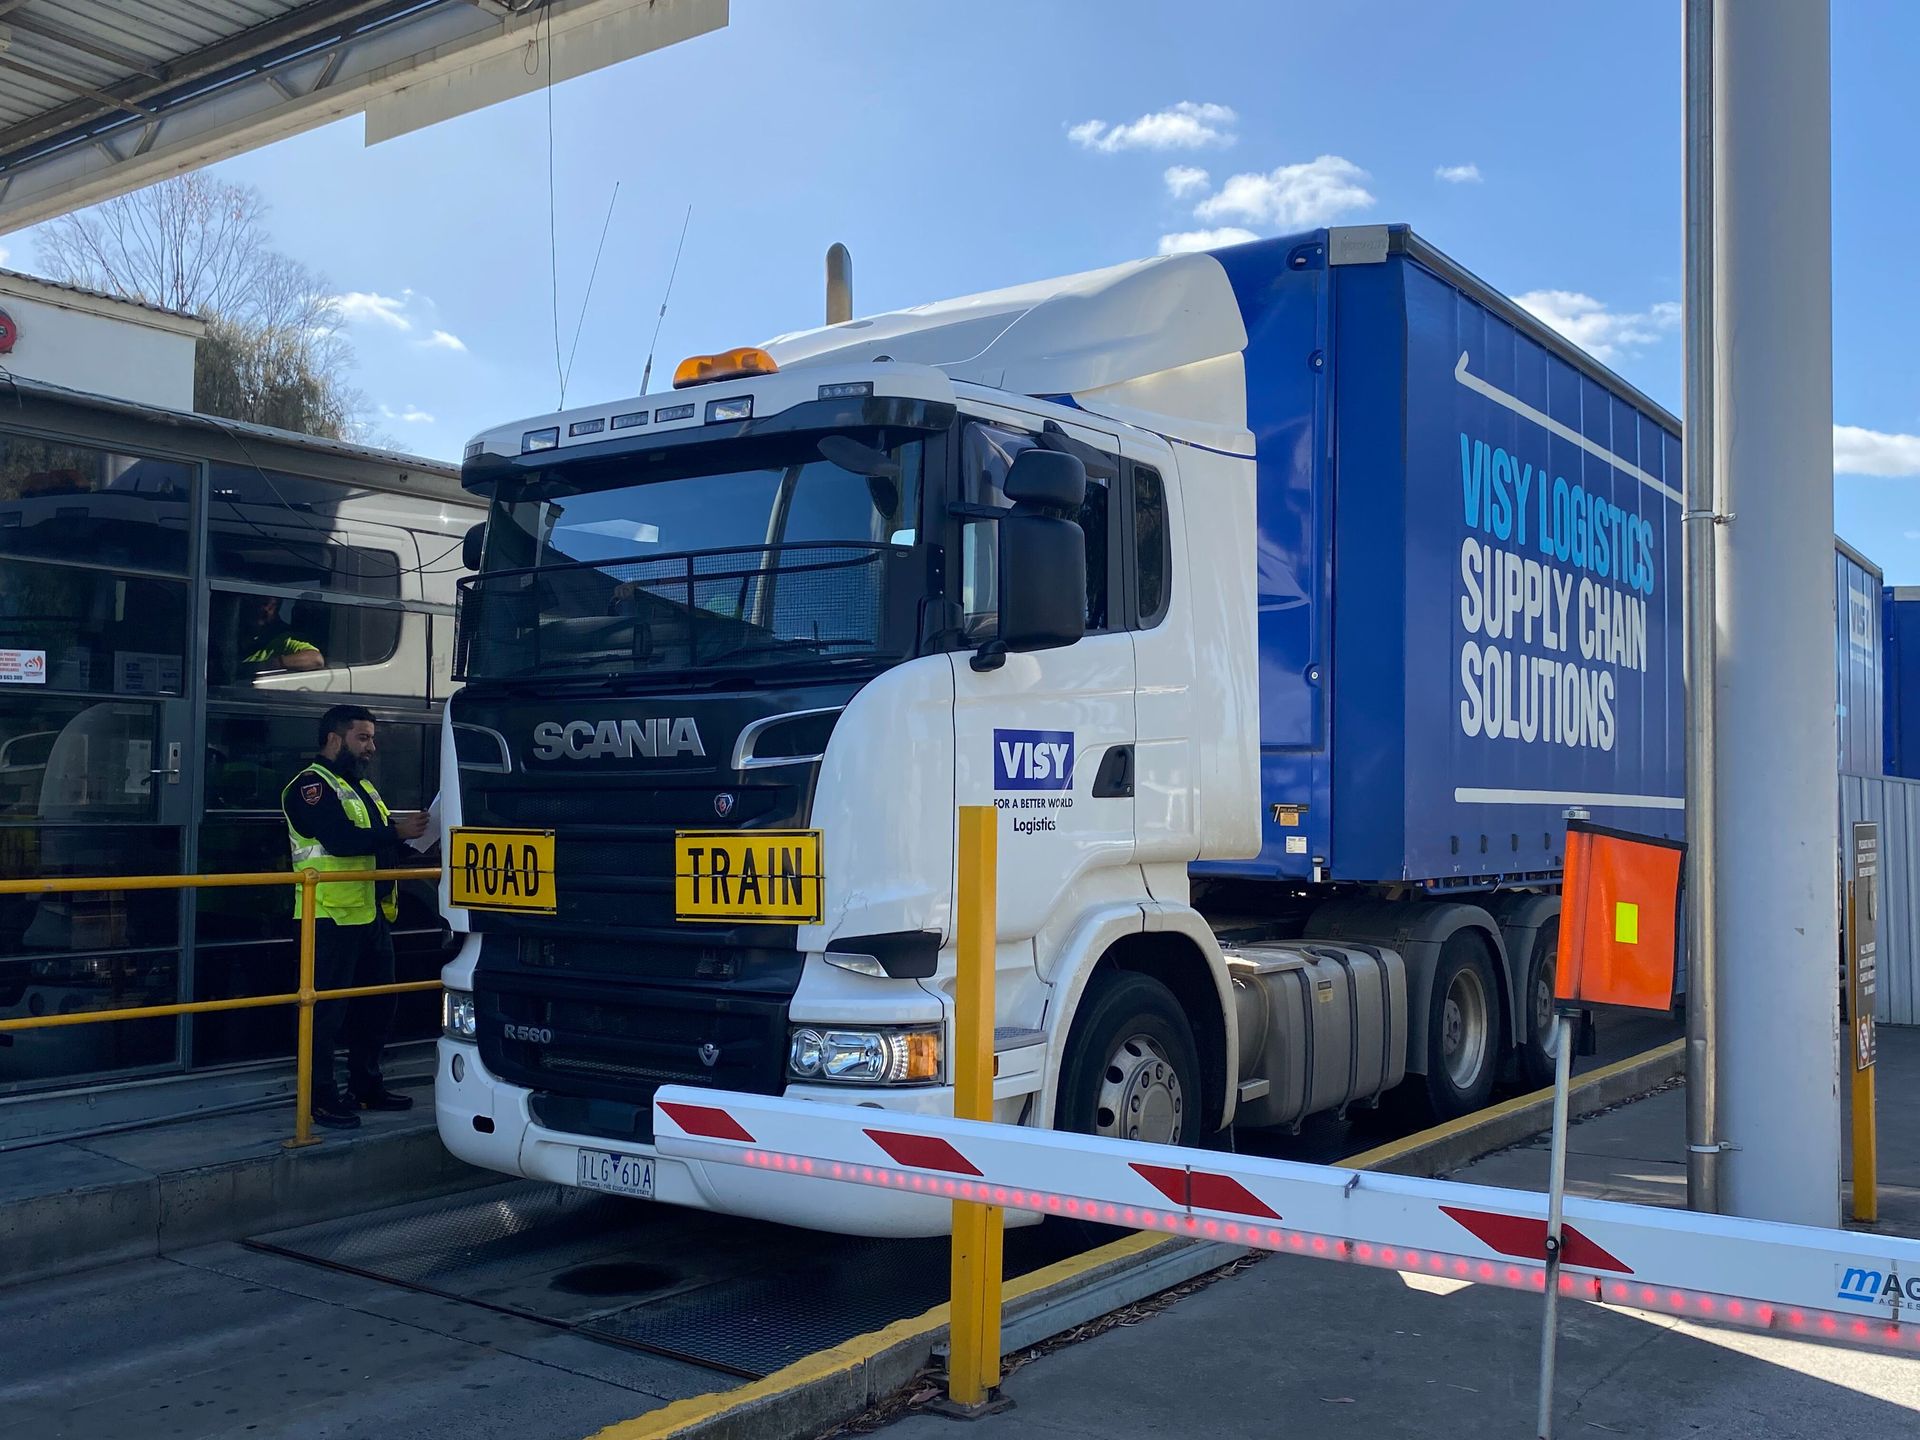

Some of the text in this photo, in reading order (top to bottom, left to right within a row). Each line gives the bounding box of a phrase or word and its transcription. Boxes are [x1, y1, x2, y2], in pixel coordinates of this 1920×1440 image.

[1460, 432, 1654, 595] VISY LOGISTICS
[1461, 536, 1647, 673] SUPPLY CHAIN
[1461, 640, 1615, 752] SOLUTIONS
[533, 717, 706, 760] SCANIA
[1000, 741, 1070, 780] VISY
[994, 798, 1073, 809] FOR A BETTER WORLD
[1013, 817, 1056, 835] Logistics
[465, 842, 539, 897] ROAD
[688, 847, 804, 906] TRAIN
